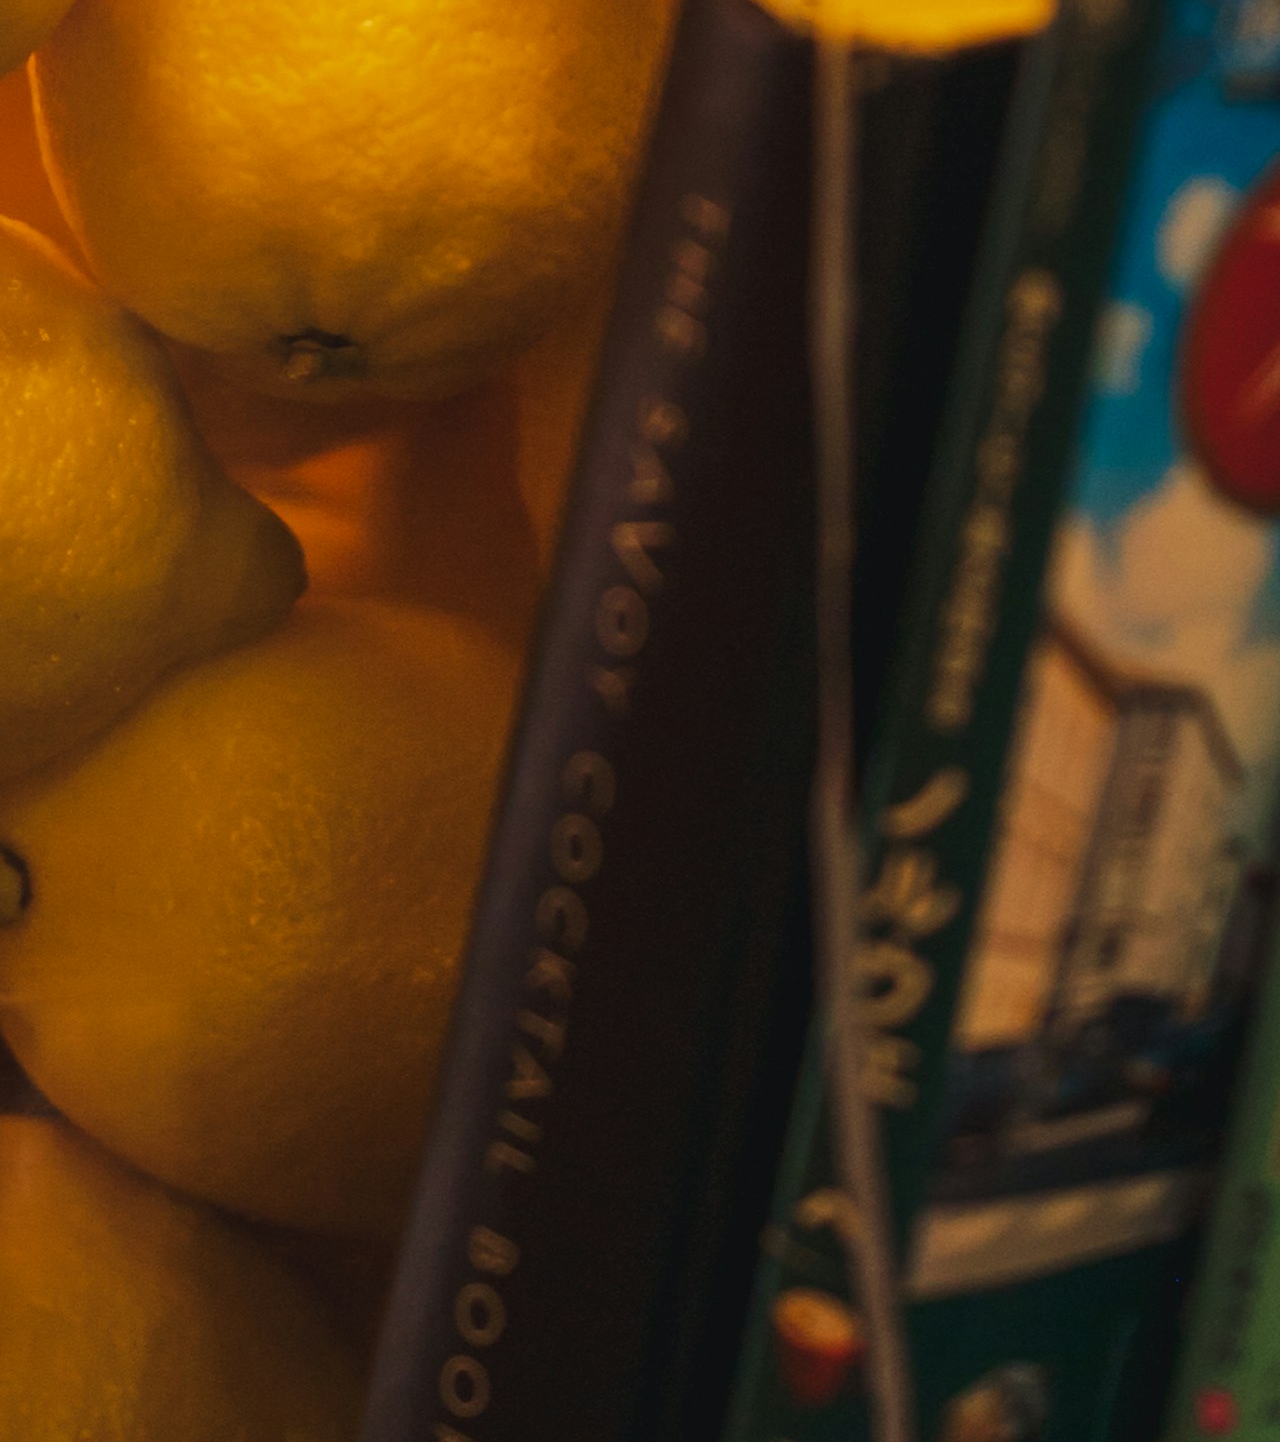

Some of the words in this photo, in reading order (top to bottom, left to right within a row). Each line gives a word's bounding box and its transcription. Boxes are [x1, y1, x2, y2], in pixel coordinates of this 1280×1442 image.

[652, 192, 732, 356] THE
[588, 397, 688, 709] SAVOY
[483, 750, 617, 1174] COCKTAIL
